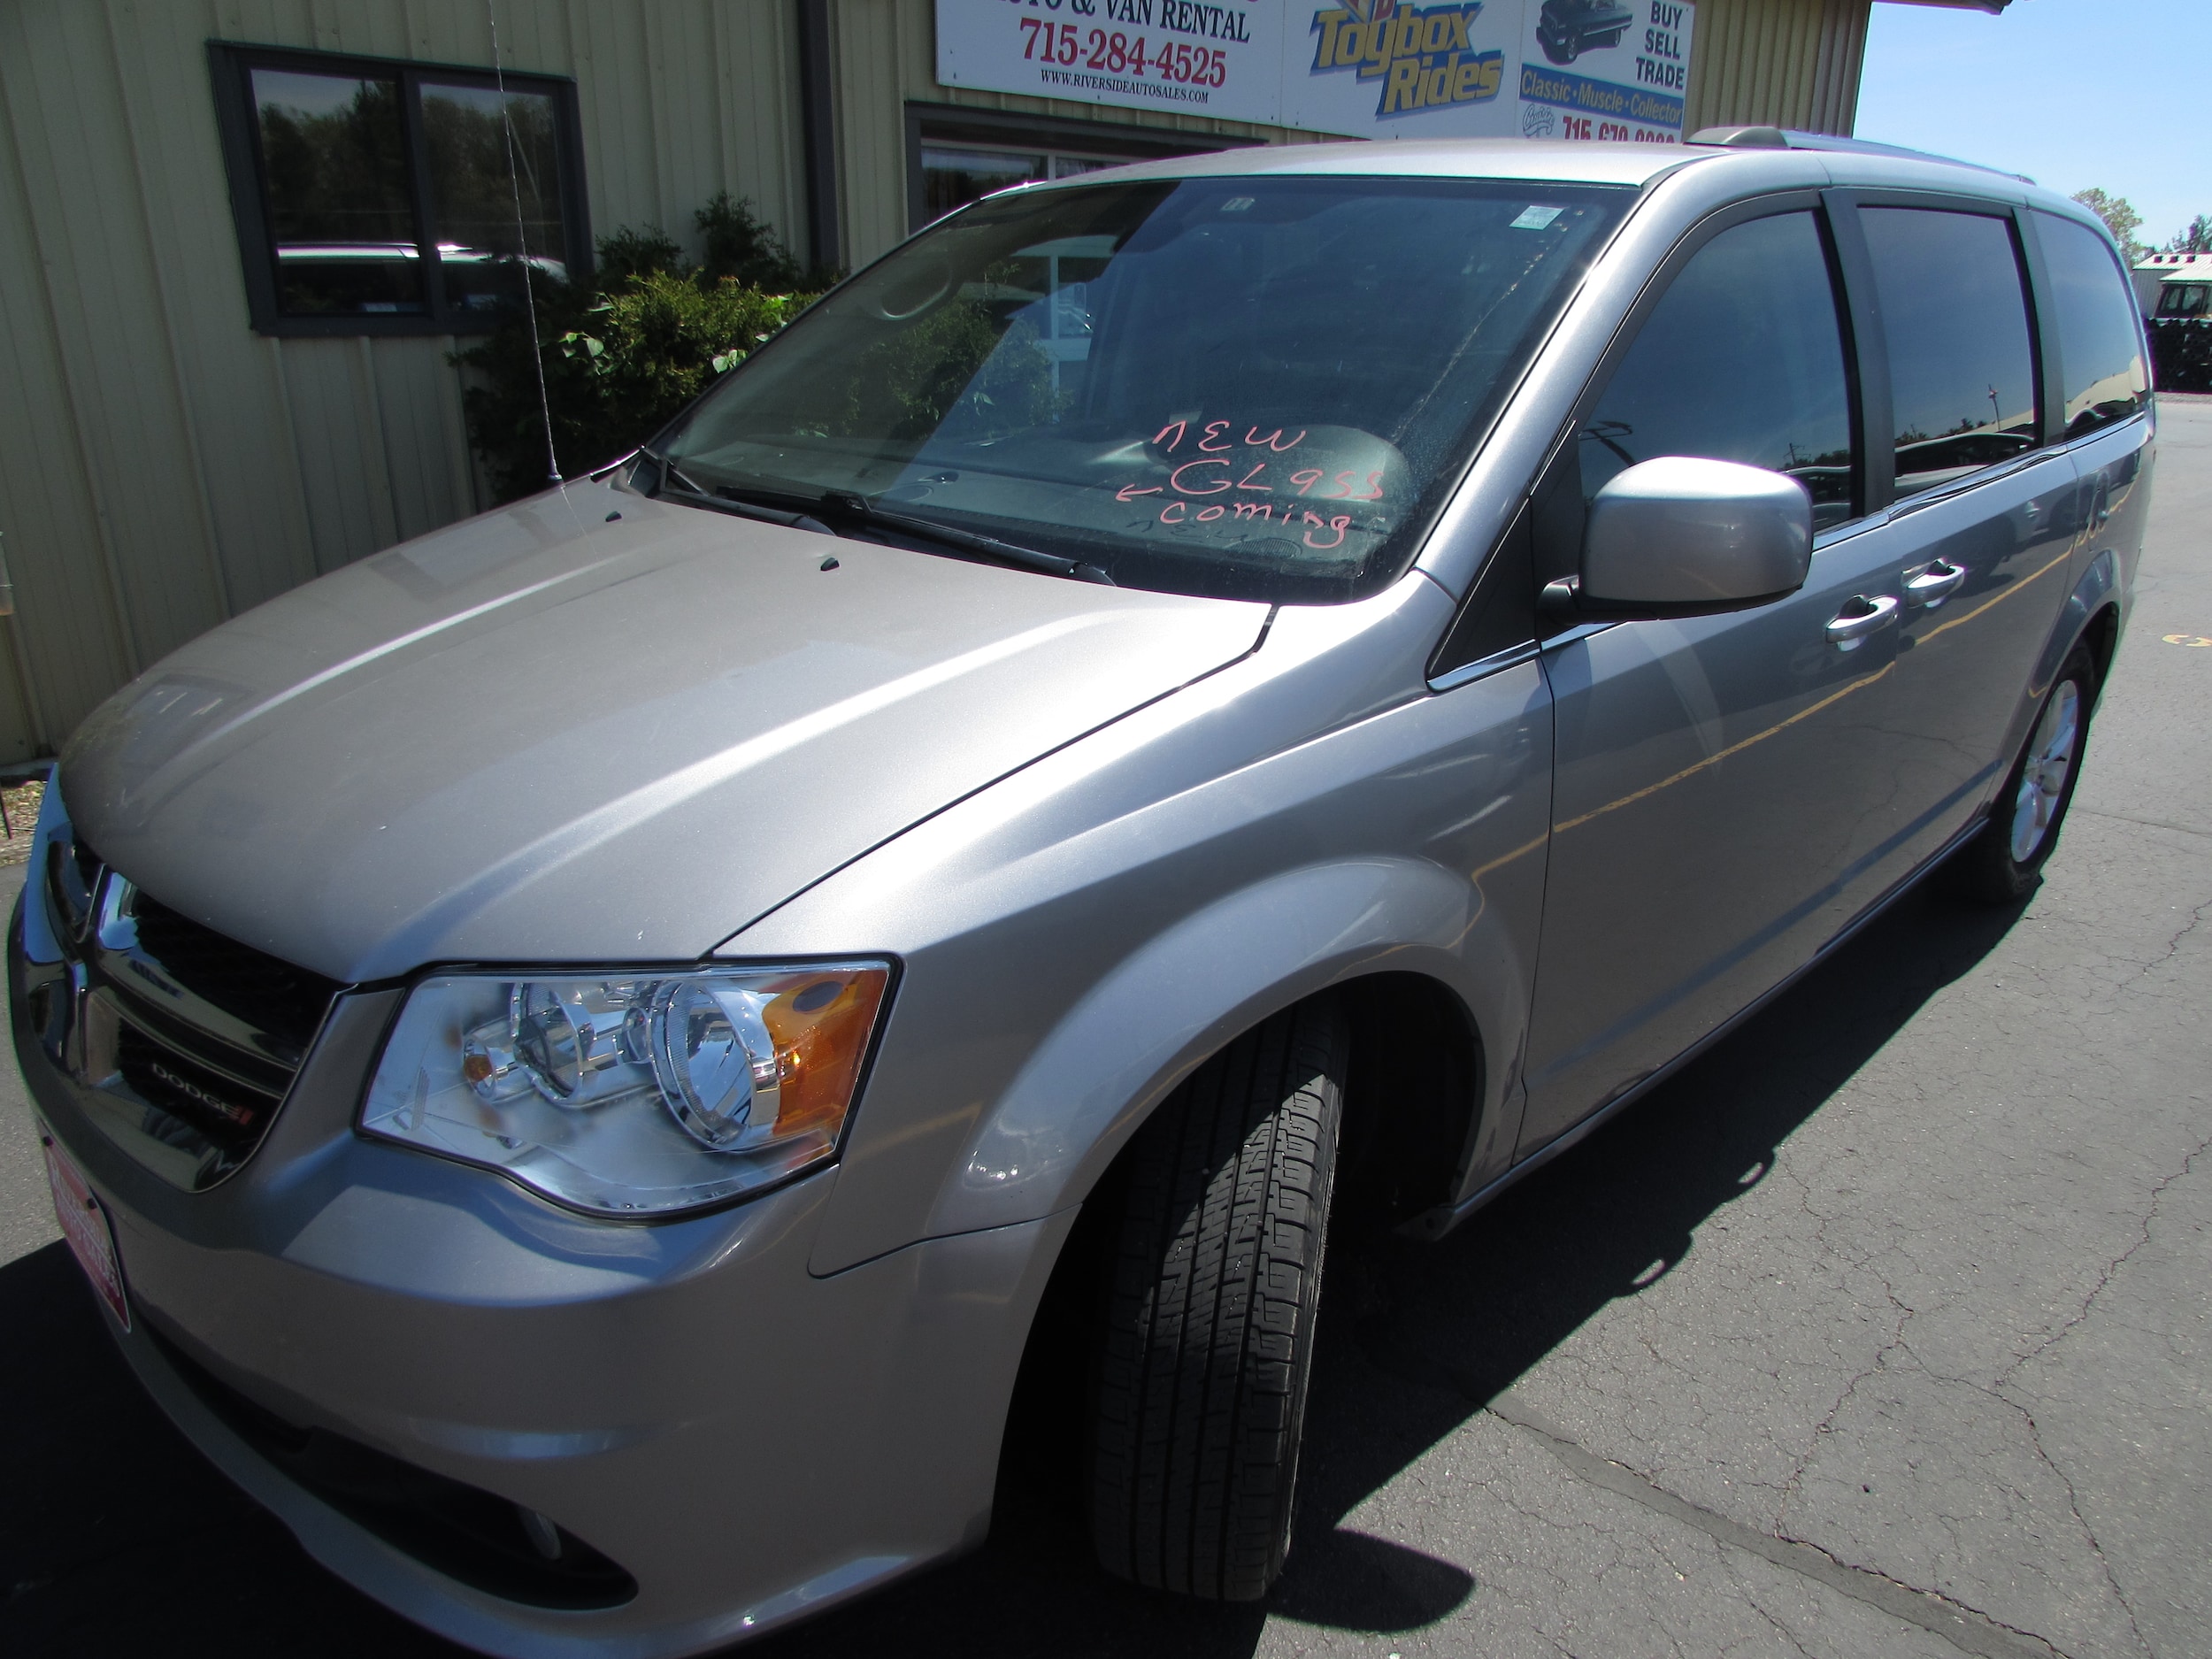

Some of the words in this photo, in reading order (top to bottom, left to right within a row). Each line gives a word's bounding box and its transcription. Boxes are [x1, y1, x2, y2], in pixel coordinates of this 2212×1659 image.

[1106, 0, 1151, 27] VAN
[1160, 4, 1251, 44] RENTAL
[1650, 1, 1683, 30] BUY
[1019, 17, 1227, 88] 715-284-4525
[1315, 4, 1479, 78] Toybox
[1644, 34, 1681, 60] SELL
[1041, 69, 1210, 104] WWW.RIVERSIDEAUTOSALES.COM
[1380, 53, 1502, 115] Rides
[1521, 69, 1571, 103] Classic
[1577, 82, 1623, 113] Muscle
[1630, 93, 1683, 125] Collector
[1635, 57, 1685, 90] TRADE
[1159, 501, 1351, 549] coming
[152, 1063, 241, 1120] DODGE
